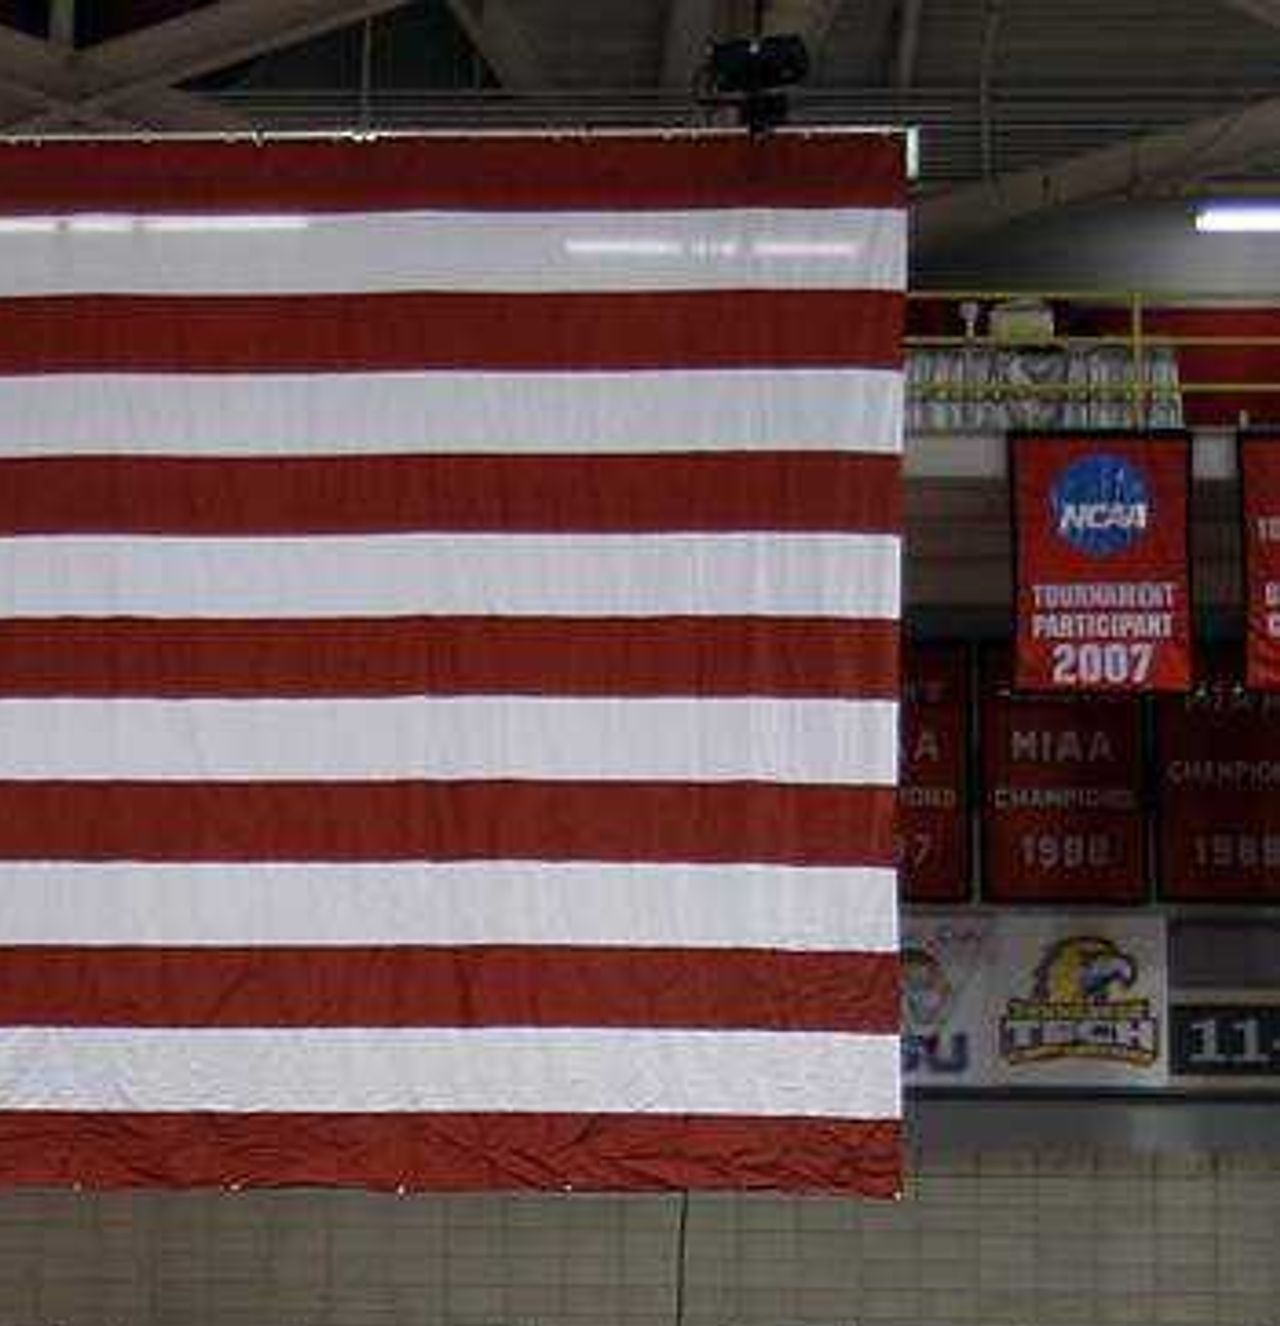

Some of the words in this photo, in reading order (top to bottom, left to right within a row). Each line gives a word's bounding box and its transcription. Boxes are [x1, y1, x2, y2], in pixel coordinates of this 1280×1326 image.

[1057, 504, 1148, 529] NCAA
[1032, 583, 1175, 608] TOURNAMENT
[1032, 614, 1172, 639] PARTICIPANT
[1053, 643, 1155, 684] 2007
[1010, 731, 1116, 763] MIAA
[1187, 1018, 1280, 1062] 11
